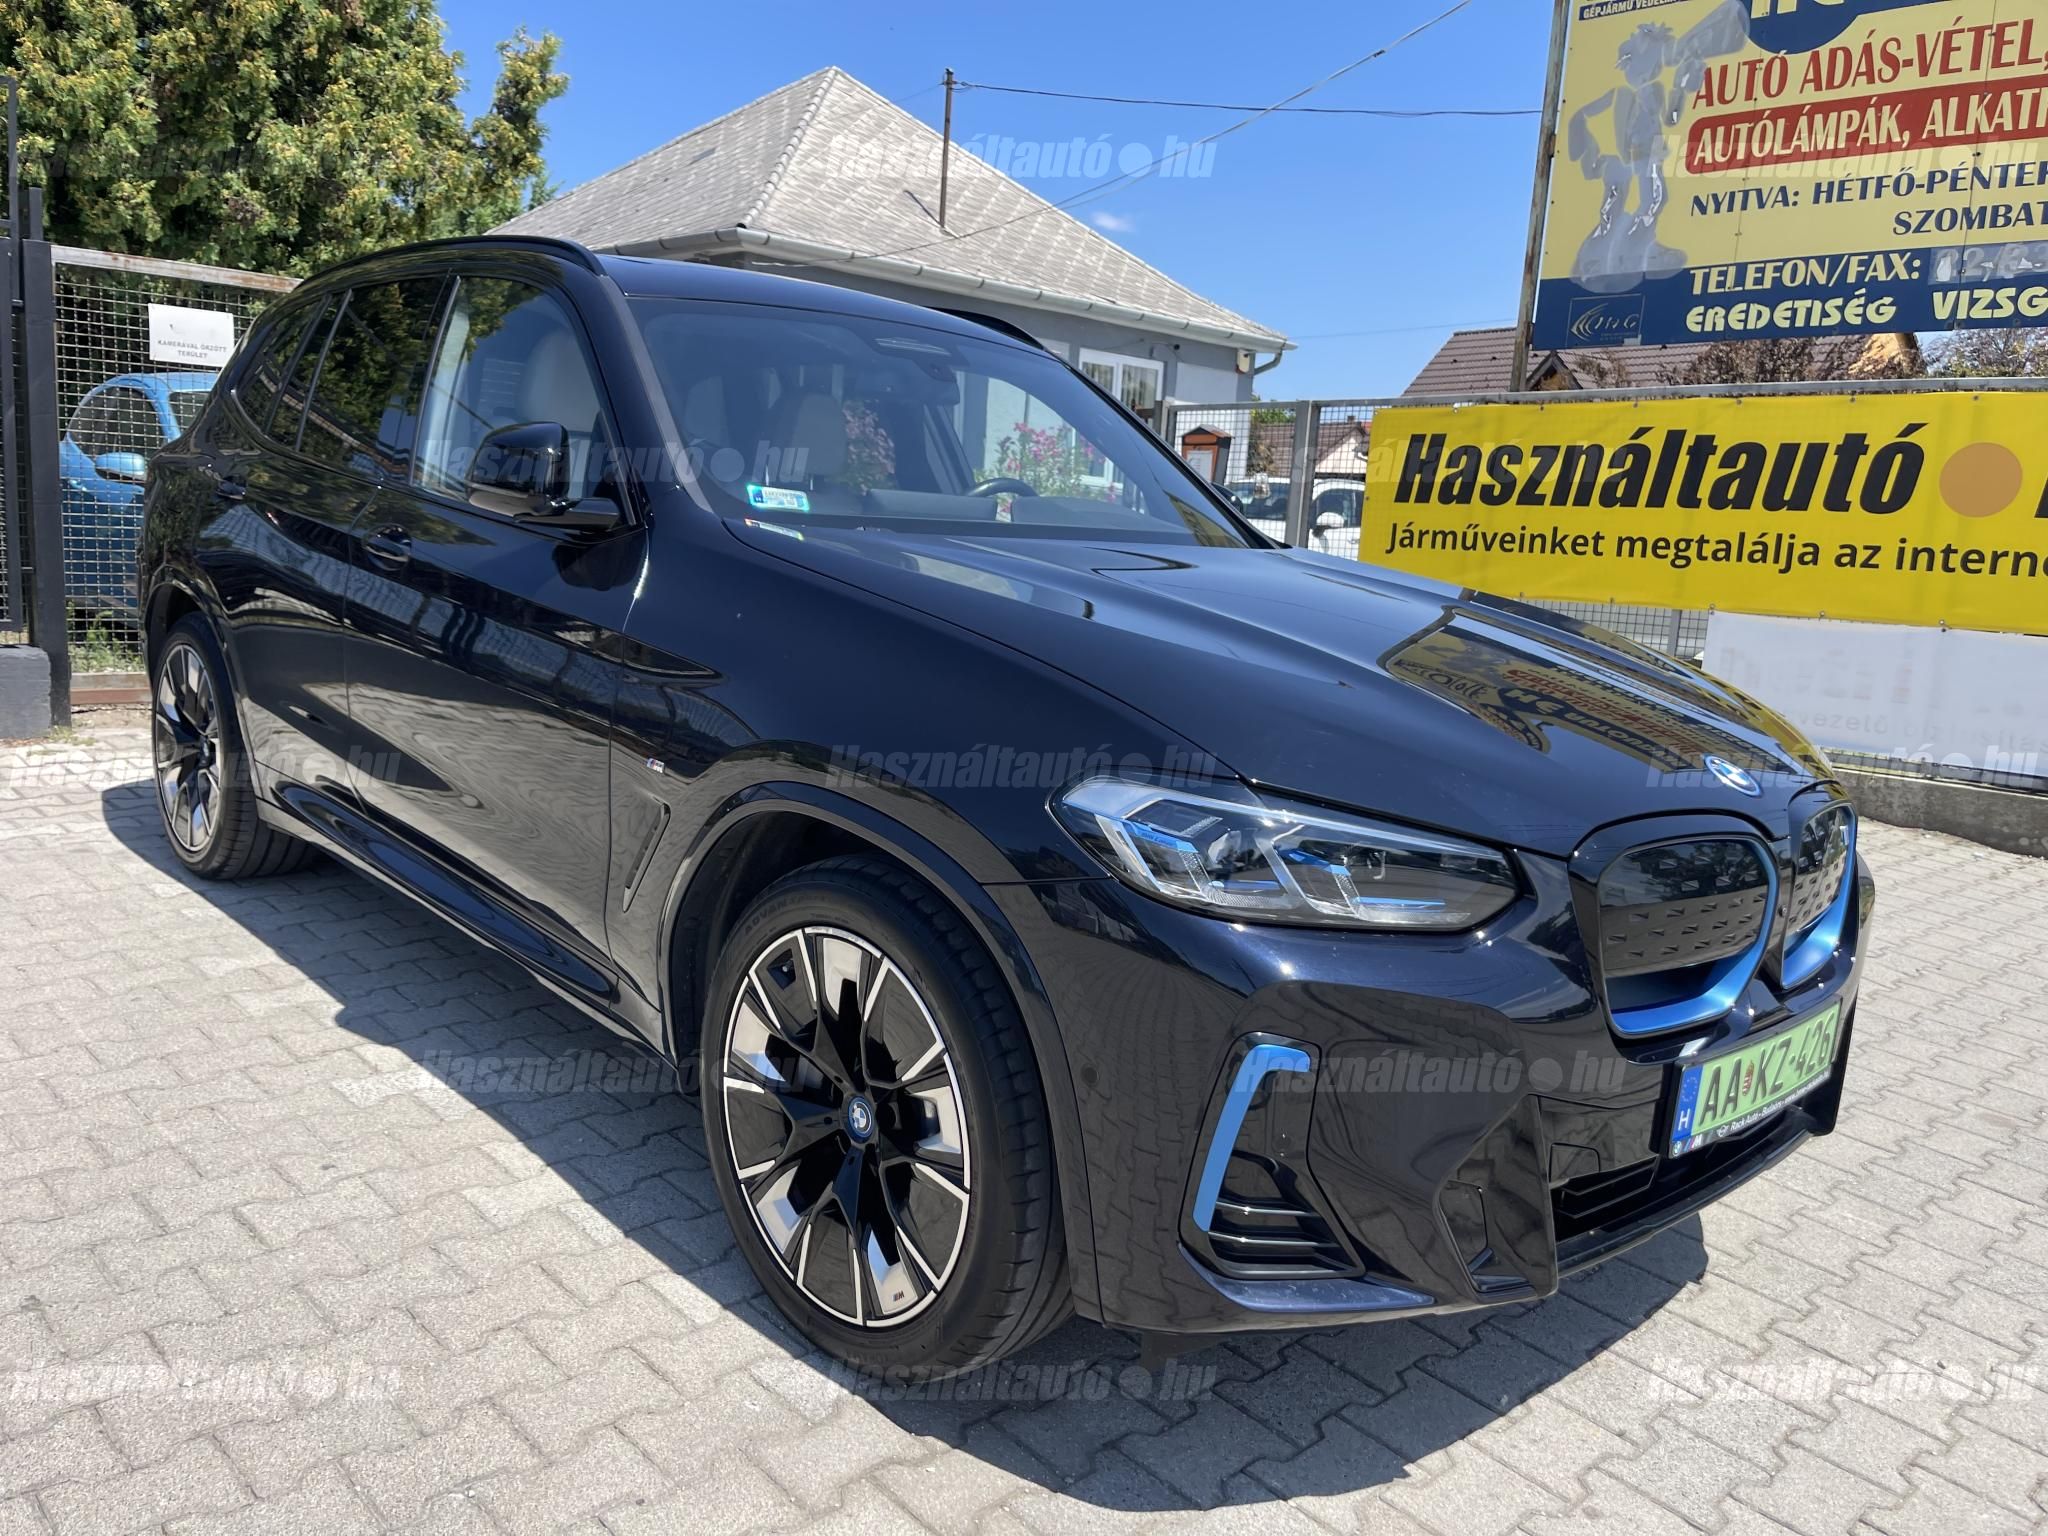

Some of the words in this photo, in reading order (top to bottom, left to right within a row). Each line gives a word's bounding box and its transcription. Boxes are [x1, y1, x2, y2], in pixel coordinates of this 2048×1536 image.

[1692, 50, 1789, 109] AUTÓ
[1693, 97, 1911, 166] AUTÓLÁMPÁK,
[1691, 185, 1799, 216] NYITVA:
[1690, 251, 1921, 295] TELEFON/FAX:
[1686, 288, 1897, 333] EREDETISÉG
[1394, 422, 1928, 514] Használtautó
[1385, 521, 1605, 555] Járműveinket
[1616, 531, 1820, 574] megtalálja
[1835, 543, 1882, 569] az
